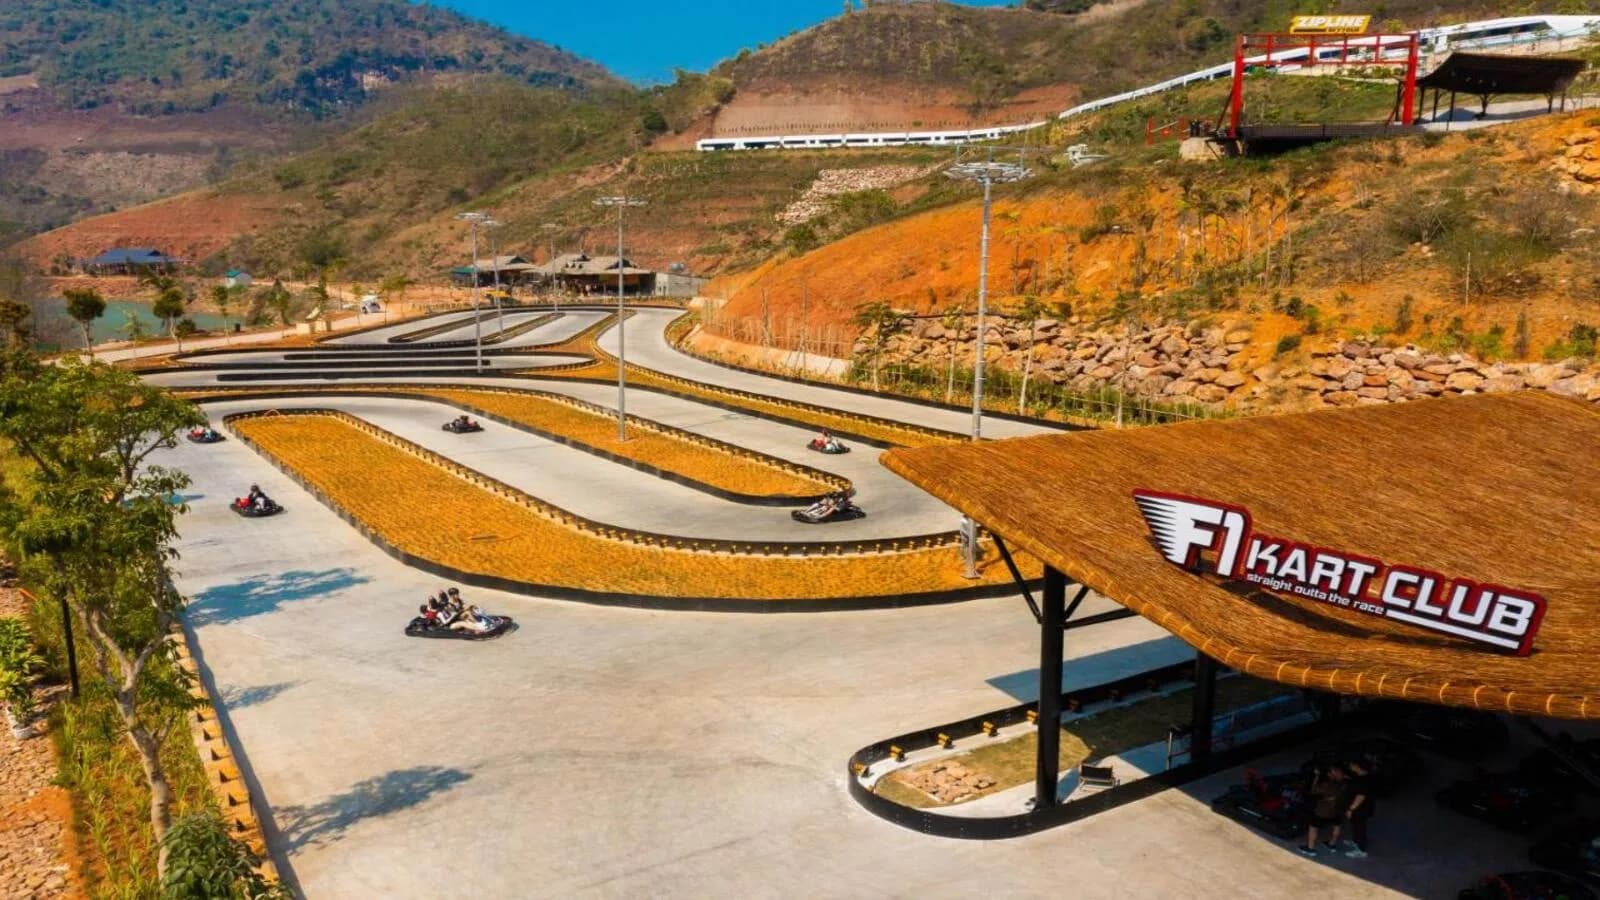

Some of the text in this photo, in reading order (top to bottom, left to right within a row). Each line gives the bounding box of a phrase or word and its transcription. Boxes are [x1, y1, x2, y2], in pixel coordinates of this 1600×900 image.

[1297, 15, 1366, 27] ZIPLINE
[1136, 495, 1536, 637] F1 KART CLUB
[1246, 573, 1385, 615] straight outta the race
